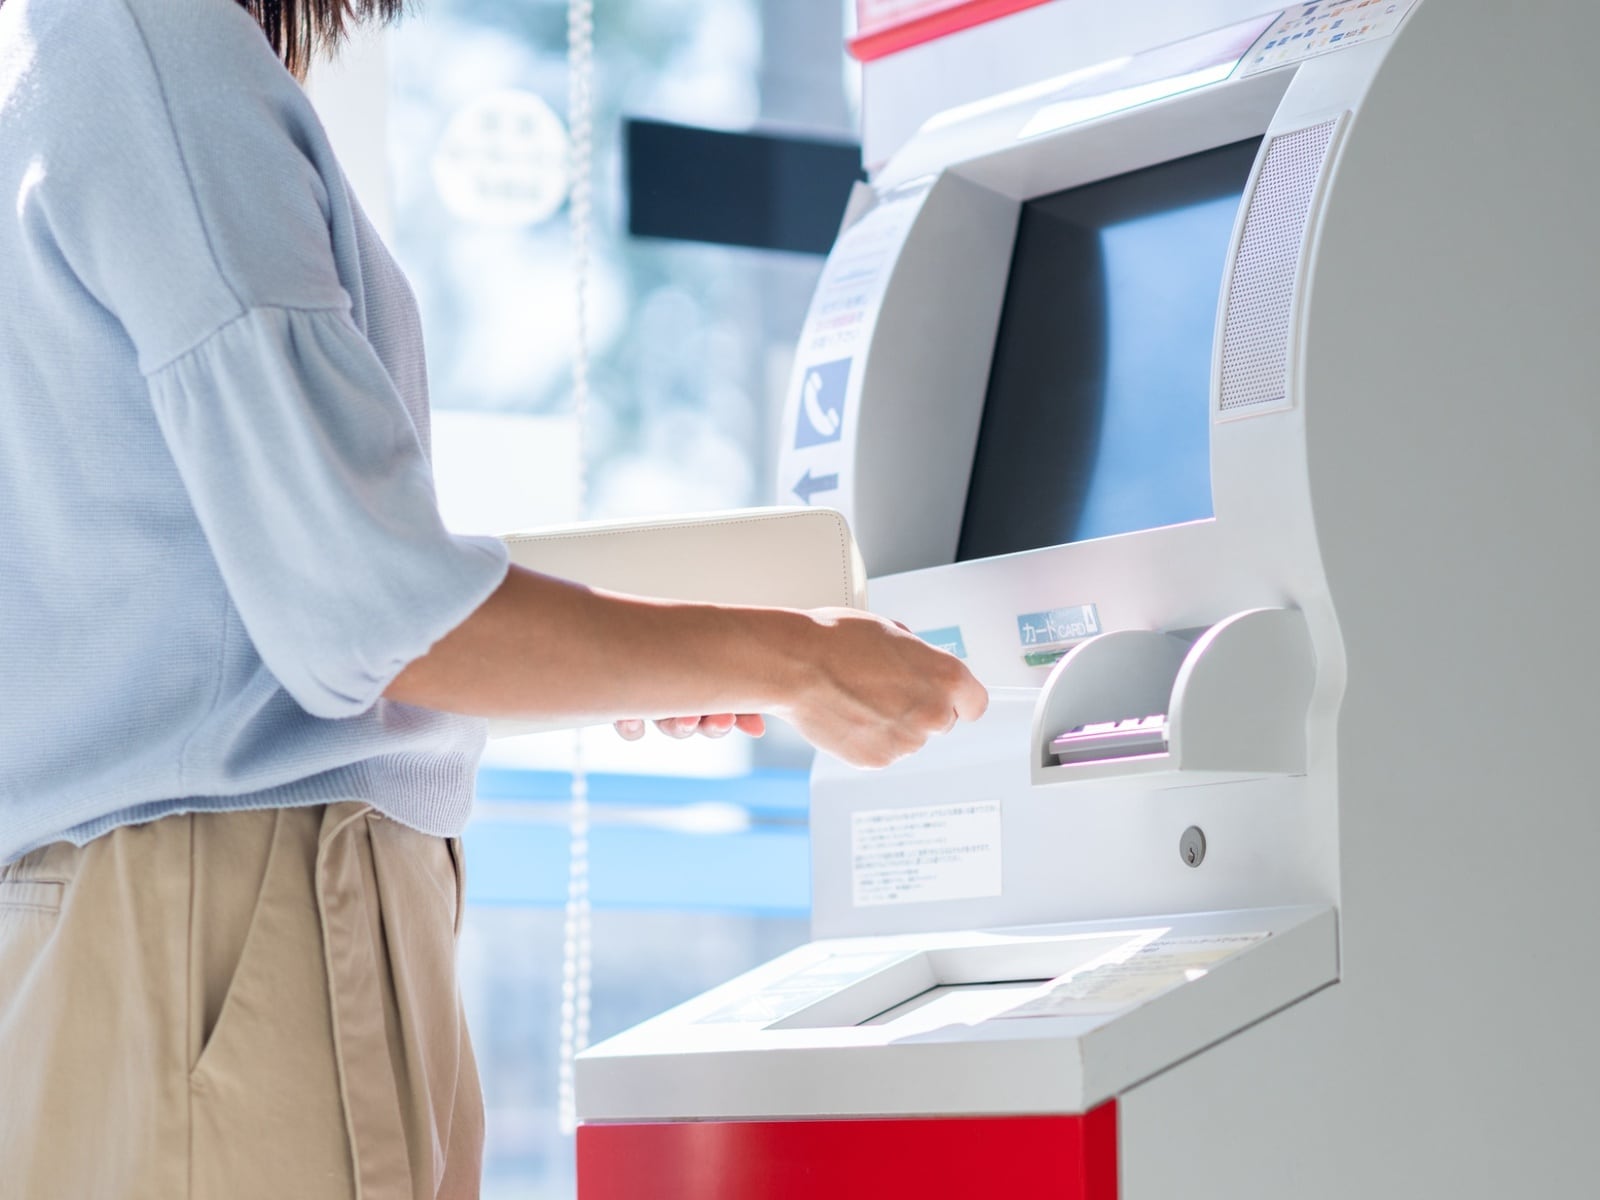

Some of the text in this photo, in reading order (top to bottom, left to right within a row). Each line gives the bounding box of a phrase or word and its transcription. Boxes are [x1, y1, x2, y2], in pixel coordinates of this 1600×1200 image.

[1022, 613, 1086, 643] カード CARD
